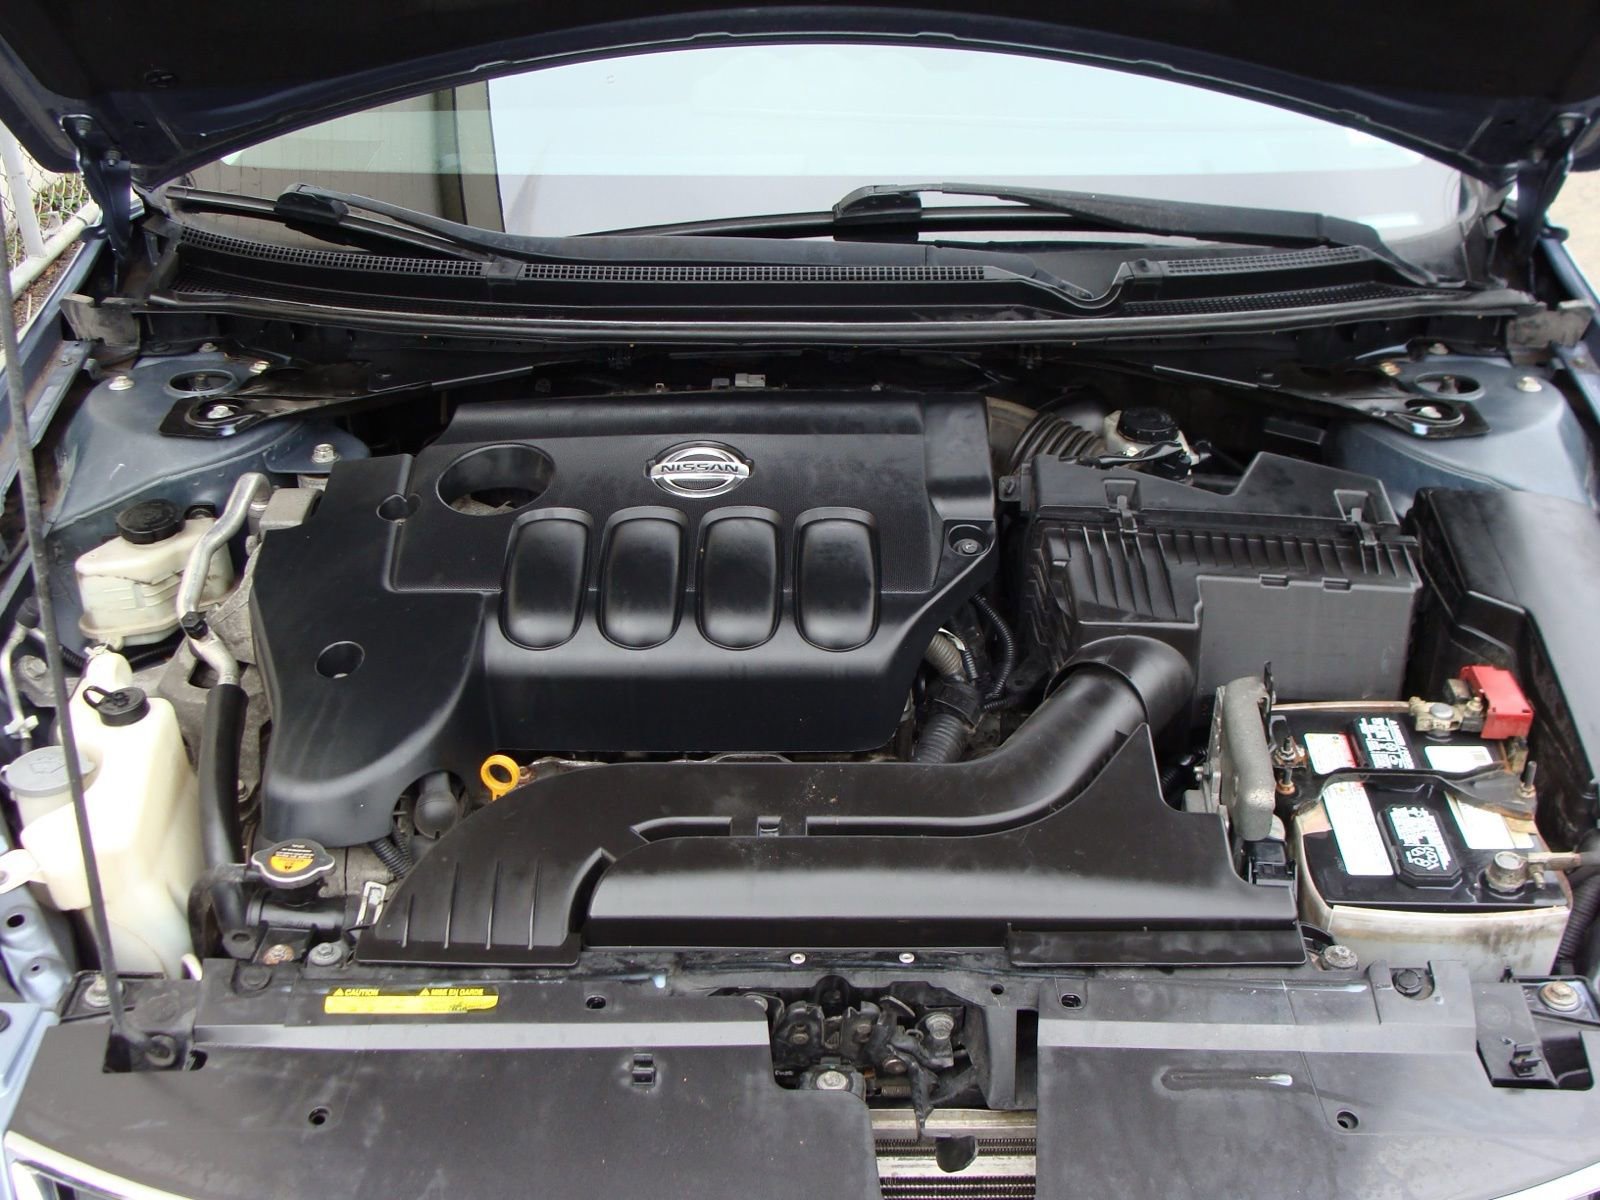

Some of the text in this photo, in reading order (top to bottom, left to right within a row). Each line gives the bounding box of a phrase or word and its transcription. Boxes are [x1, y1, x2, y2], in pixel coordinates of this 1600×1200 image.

[660, 463, 739, 473] NISSAN
[345, 988, 379, 996] CAUTION
[460, 988, 484, 996] GARDE
